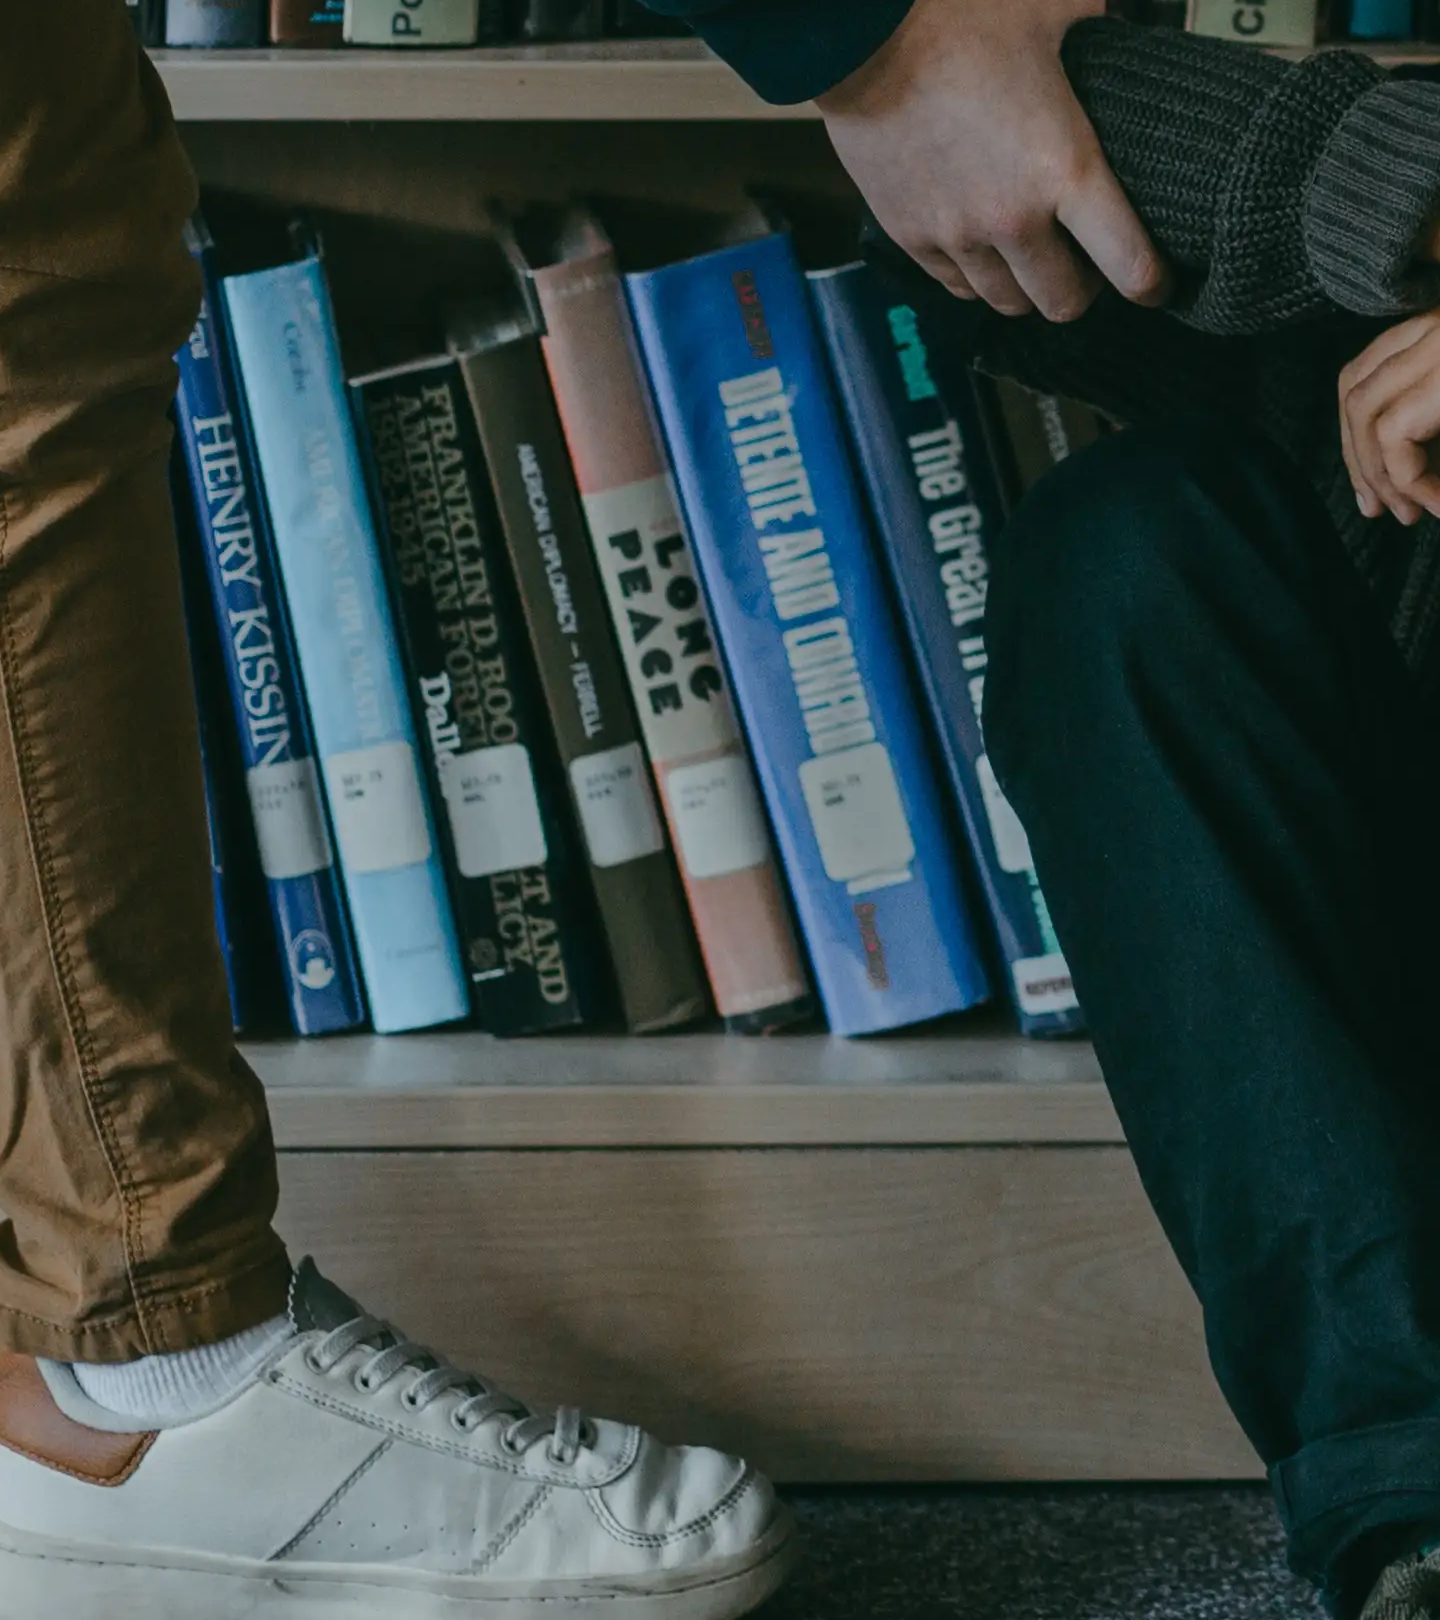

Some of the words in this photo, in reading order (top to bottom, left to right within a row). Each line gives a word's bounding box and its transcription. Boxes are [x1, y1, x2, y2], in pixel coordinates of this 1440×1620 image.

[192, 412, 262, 591] HENRY
[516, 443, 558, 532] AMERICAN
[907, 420, 966, 499] The
[535, 532, 579, 636] DIPLOMACY
[607, 526, 683, 718] PEACE
[654, 532, 723, 705] LONG
[757, 529, 842, 620] AND
[421, 381, 492, 606] FRANKLIN
[525, 924, 568, 1005] AND
[568, 661, 604, 740] FERRELL
